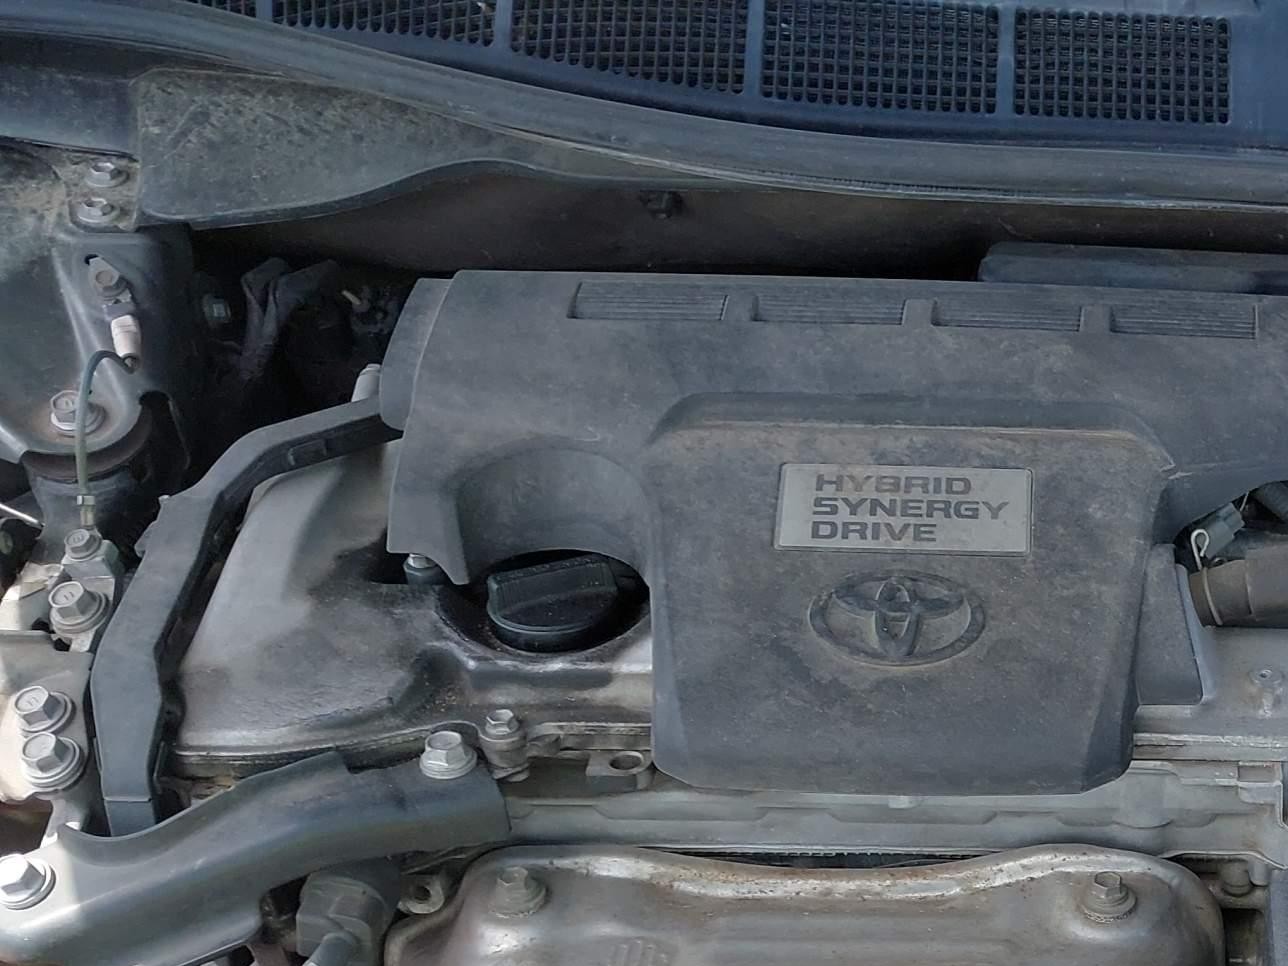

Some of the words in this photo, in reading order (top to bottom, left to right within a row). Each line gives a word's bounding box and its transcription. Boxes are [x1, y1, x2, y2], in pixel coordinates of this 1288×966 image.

[816, 474, 972, 495] HYBRID
[812, 497, 1010, 520] SYNERGY
[811, 520, 937, 542] DRIVE
